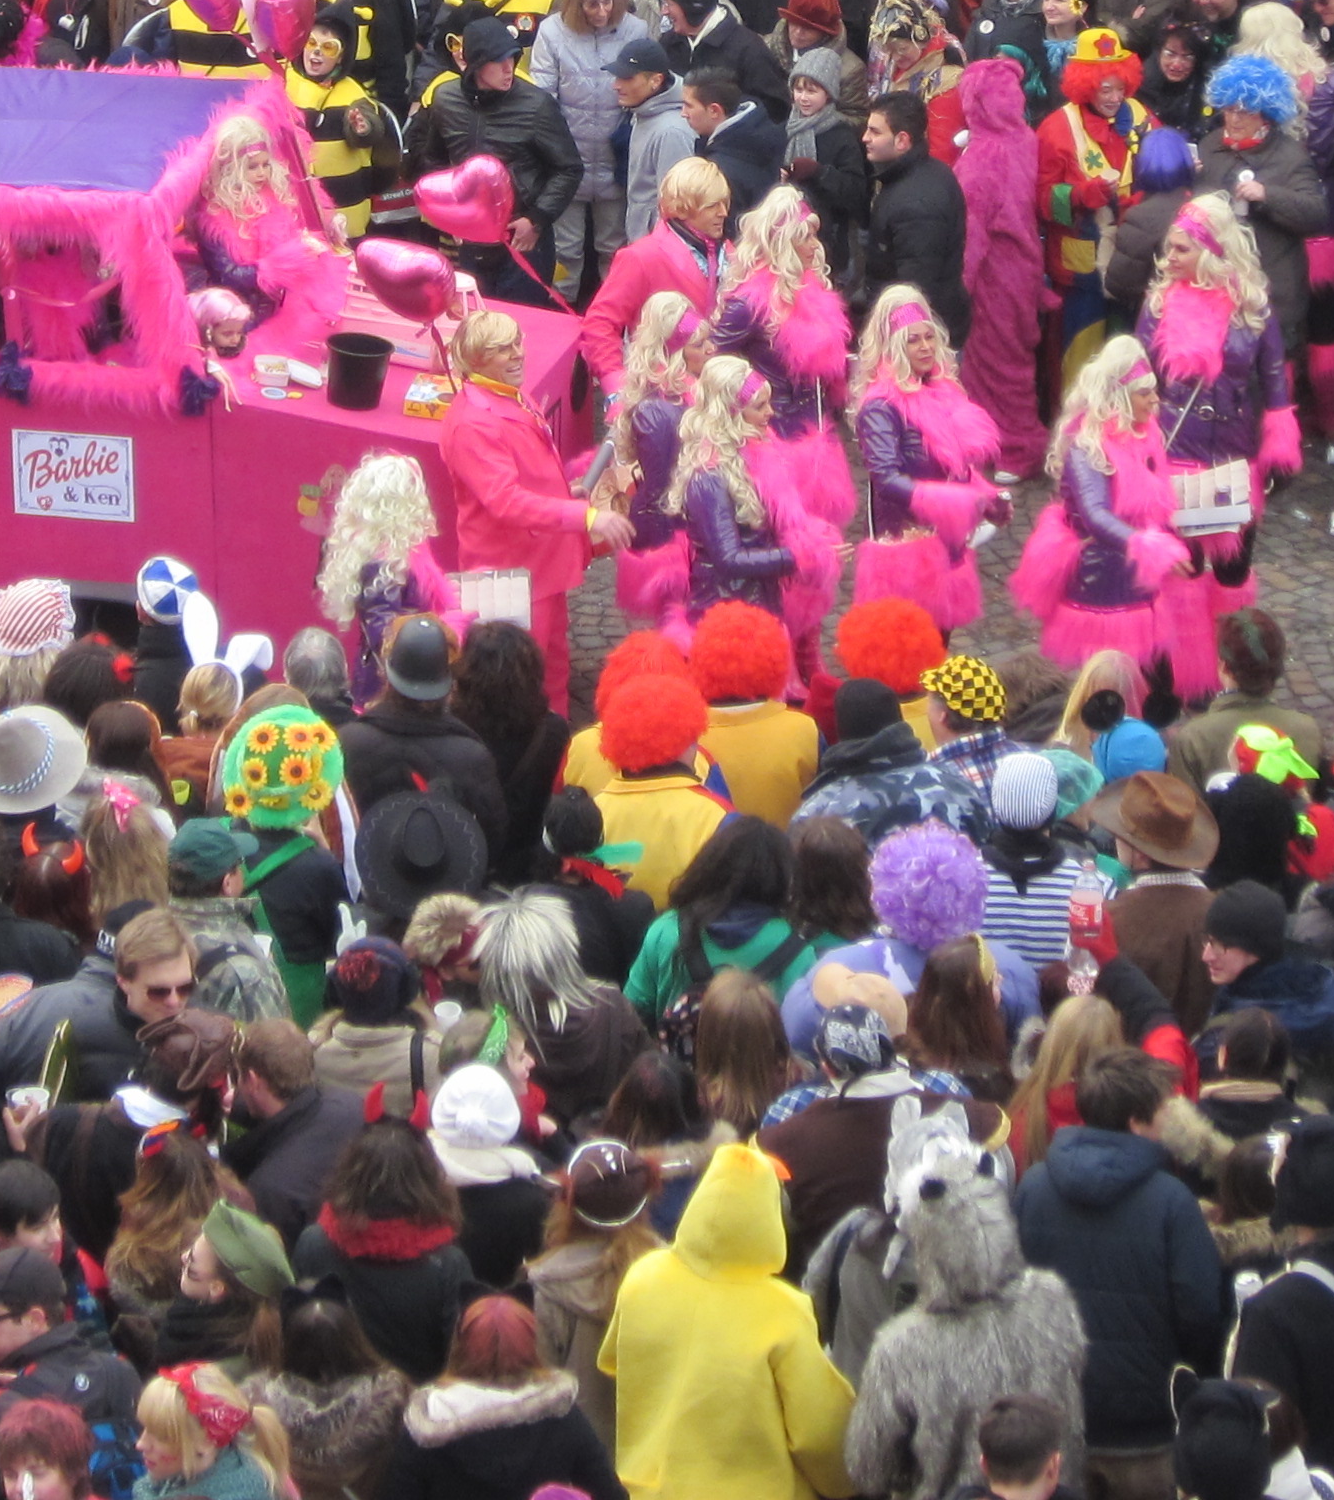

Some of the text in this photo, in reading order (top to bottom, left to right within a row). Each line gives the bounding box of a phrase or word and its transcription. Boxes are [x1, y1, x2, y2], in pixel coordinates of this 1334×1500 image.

[23, 440, 120, 493] Barbie
[63, 486, 121, 506] & Ken
